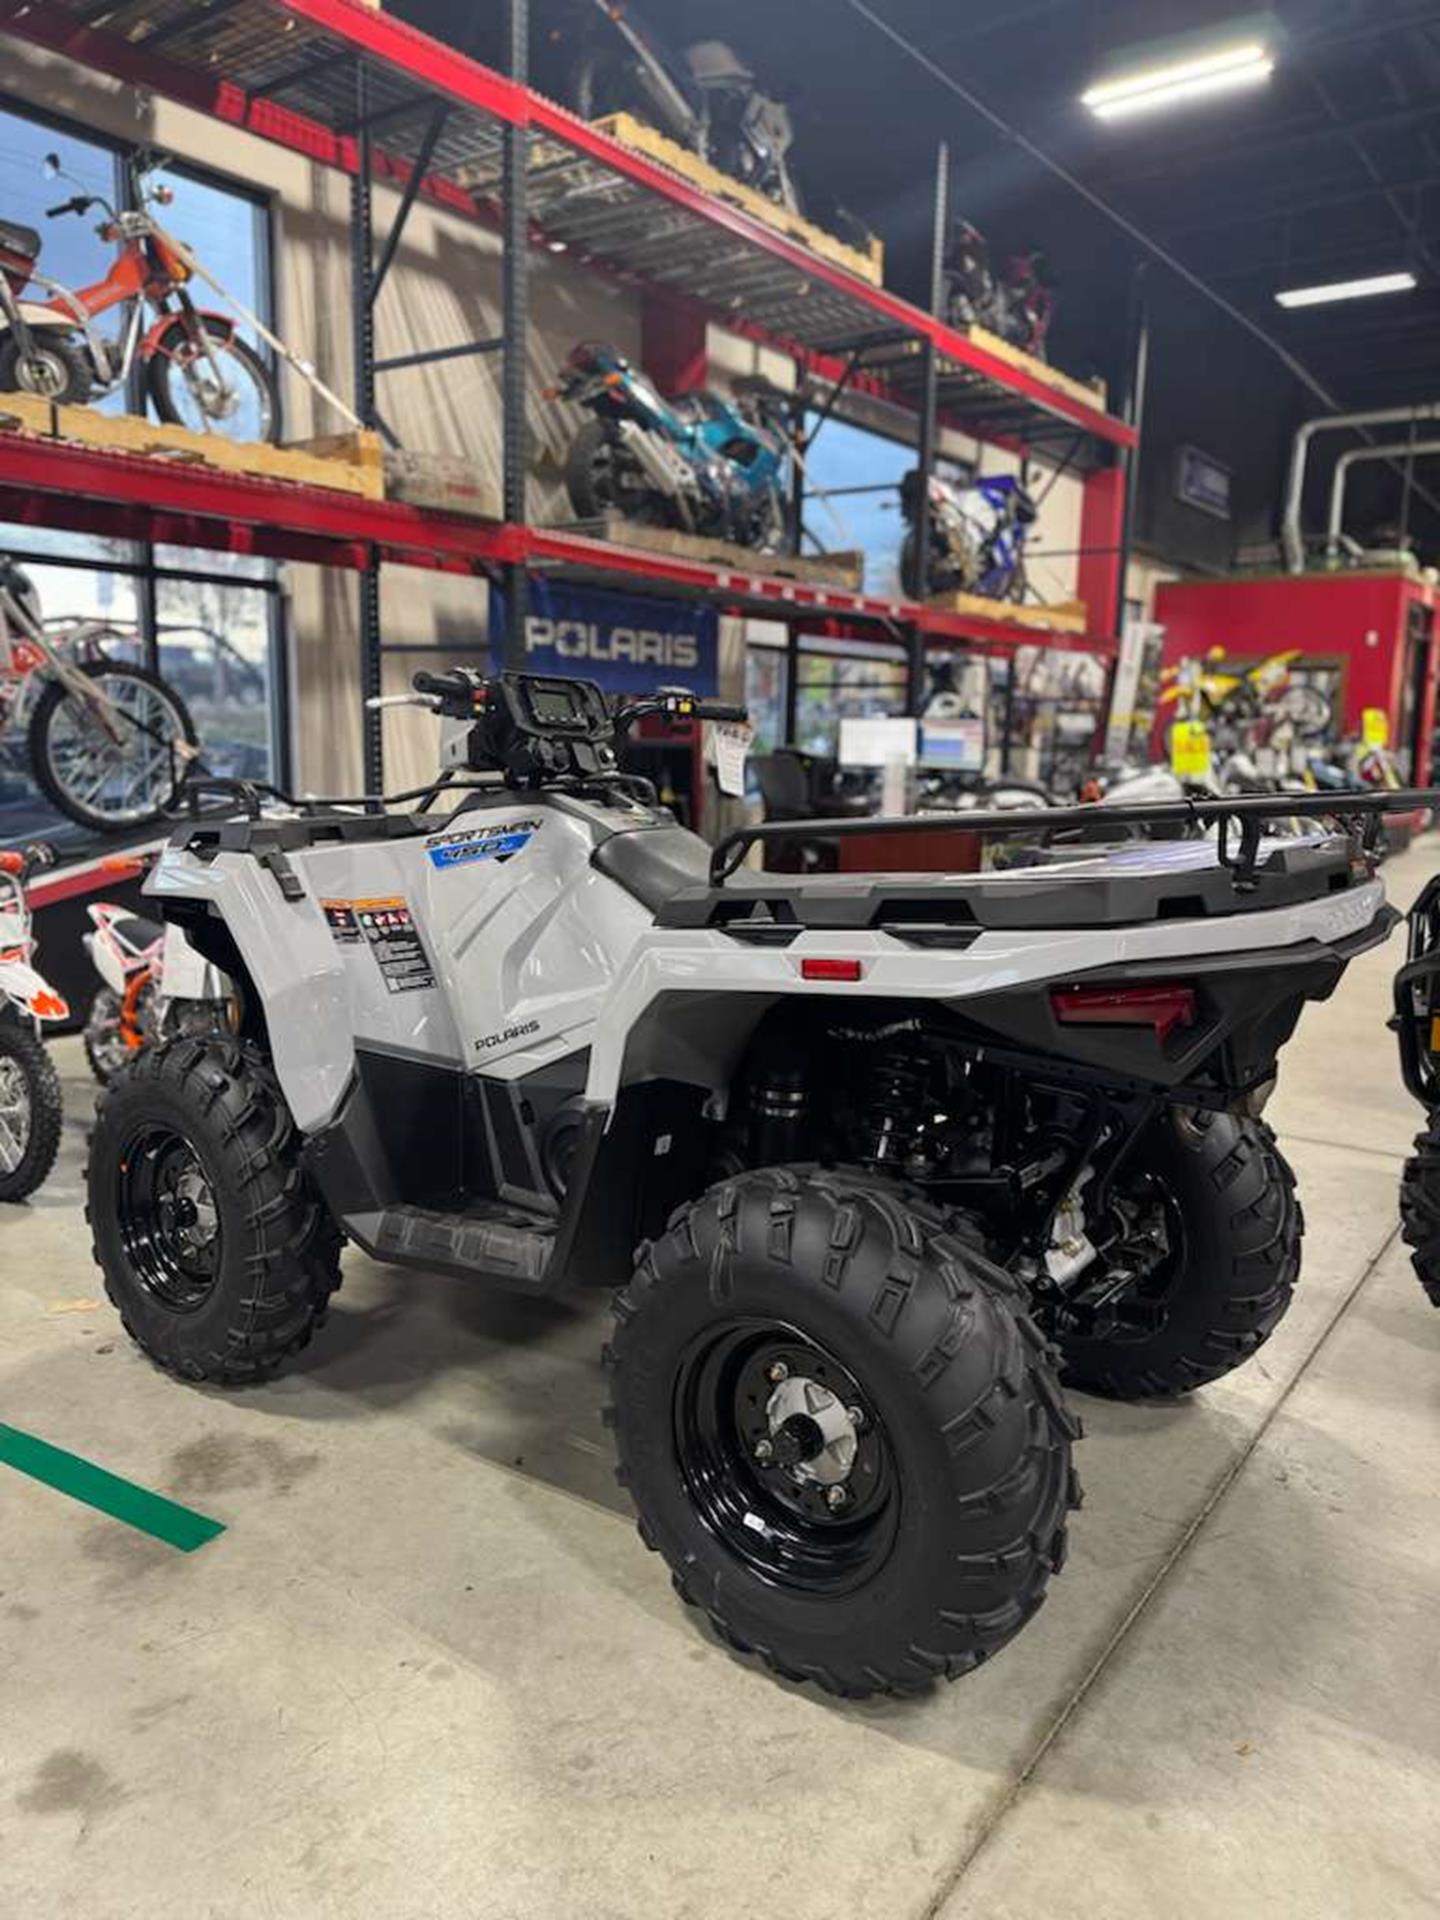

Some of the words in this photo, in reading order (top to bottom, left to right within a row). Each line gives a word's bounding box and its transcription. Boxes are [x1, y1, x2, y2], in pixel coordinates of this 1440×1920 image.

[524, 615, 699, 668] POLARIS
[425, 819, 543, 848] SPORTSMAN
[474, 1020, 541, 1051] POLARIS
